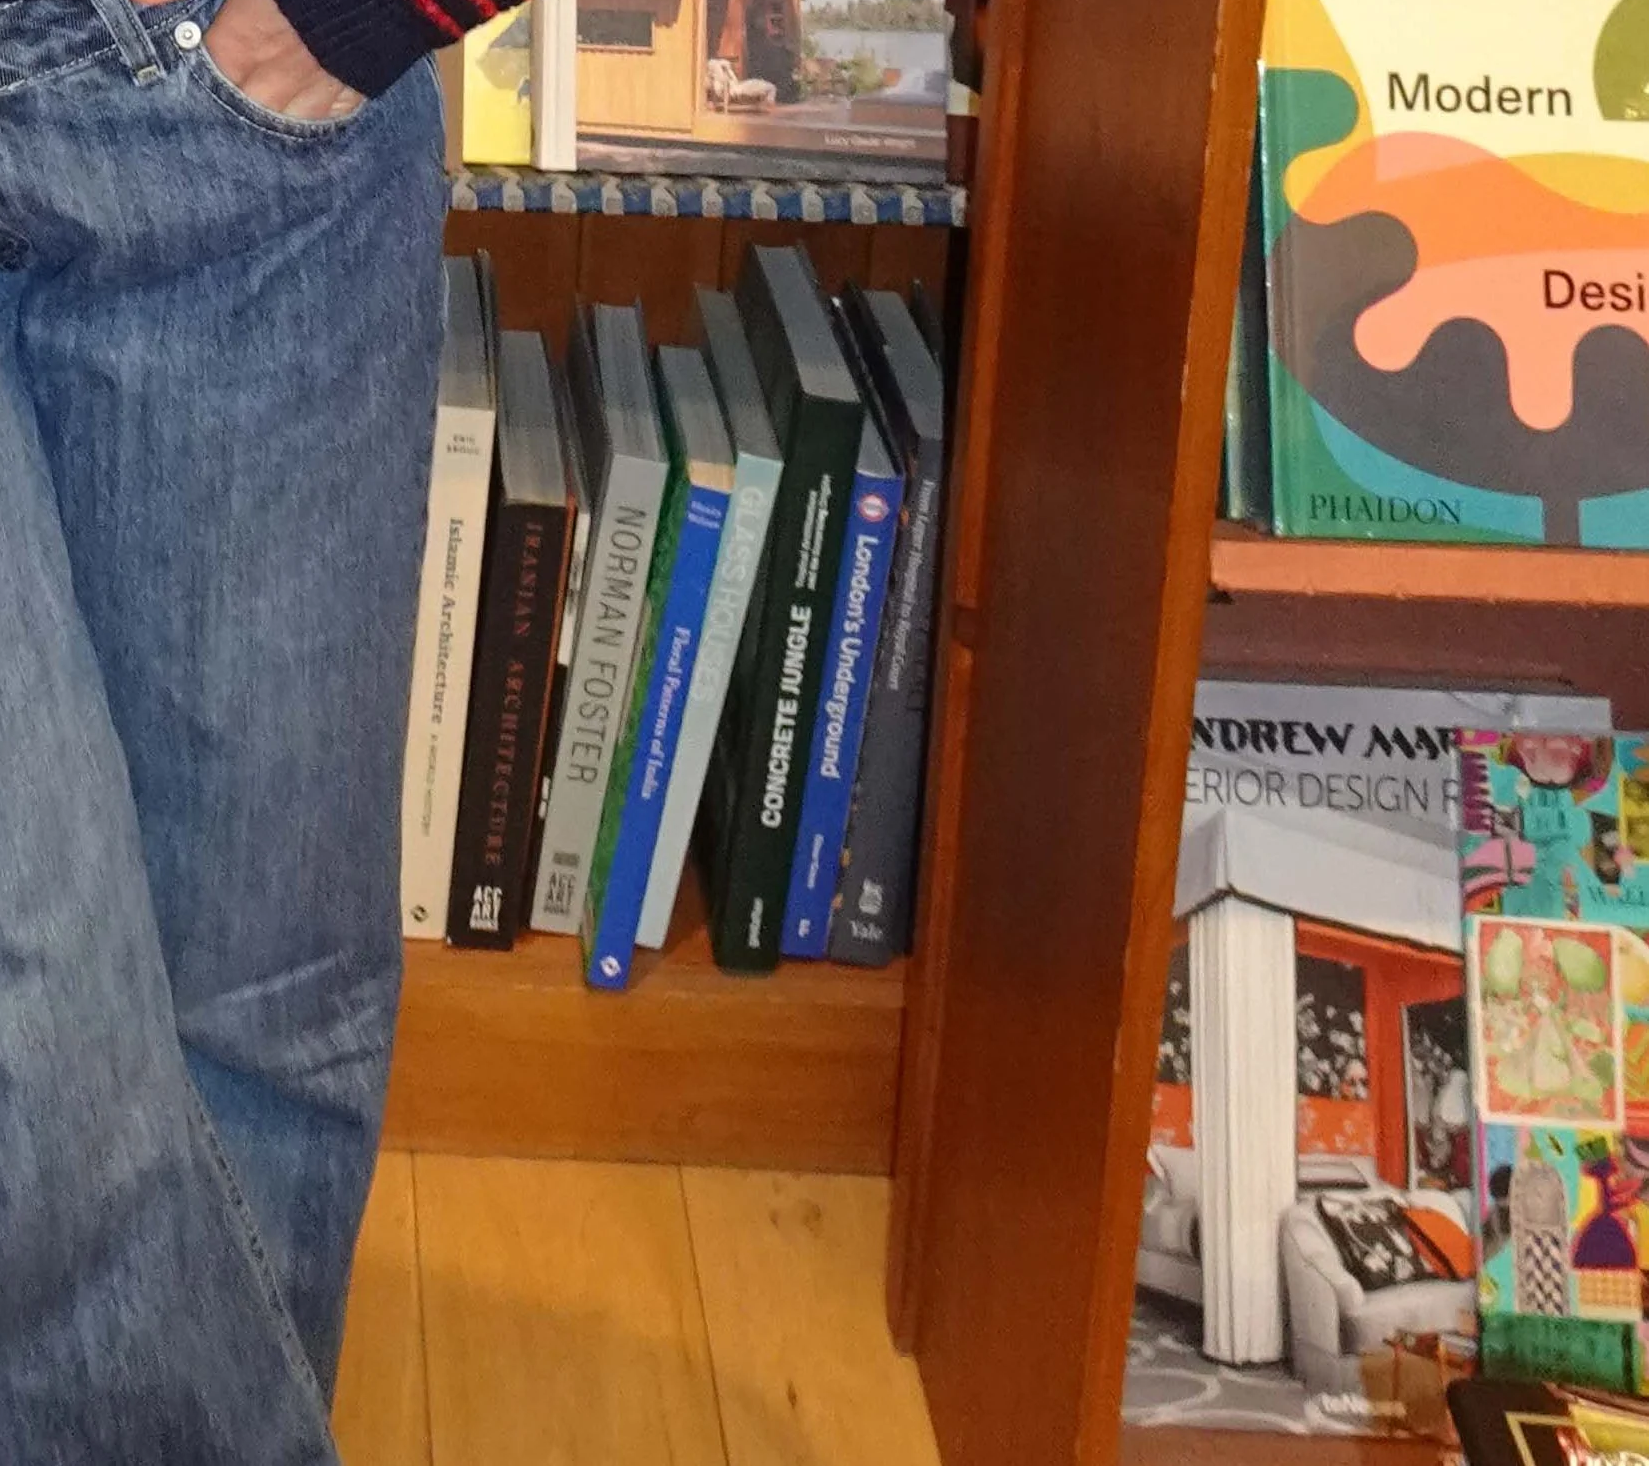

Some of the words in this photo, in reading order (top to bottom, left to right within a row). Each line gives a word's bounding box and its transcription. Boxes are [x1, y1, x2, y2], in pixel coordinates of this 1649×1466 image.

[1387, 72, 1573, 117] Modern
[1543, 269, 1649, 312] Desi
[443, 518, 465, 589] Islamic
[720, 485, 765, 581] GLASS
[1308, 494, 1465, 525] PHAIDON
[513, 521, 543, 637] IRANIAN
[592, 506, 647, 649] NORMAN
[843, 535, 880, 633] London's
[431, 595, 456, 724] Architecture
[666, 626, 692, 673] Floral
[693, 587, 746, 704] HOUSES
[567, 660, 618, 785] FOSTER
[650, 739, 665, 757] of
[759, 699, 798, 829] CONCRETE
[780, 604, 813, 695] JUNGLE
[820, 637, 863, 778] Underground
[485, 660, 526, 867] ARCHITECTURE
[1298, 773, 1430, 812] DESIGN
